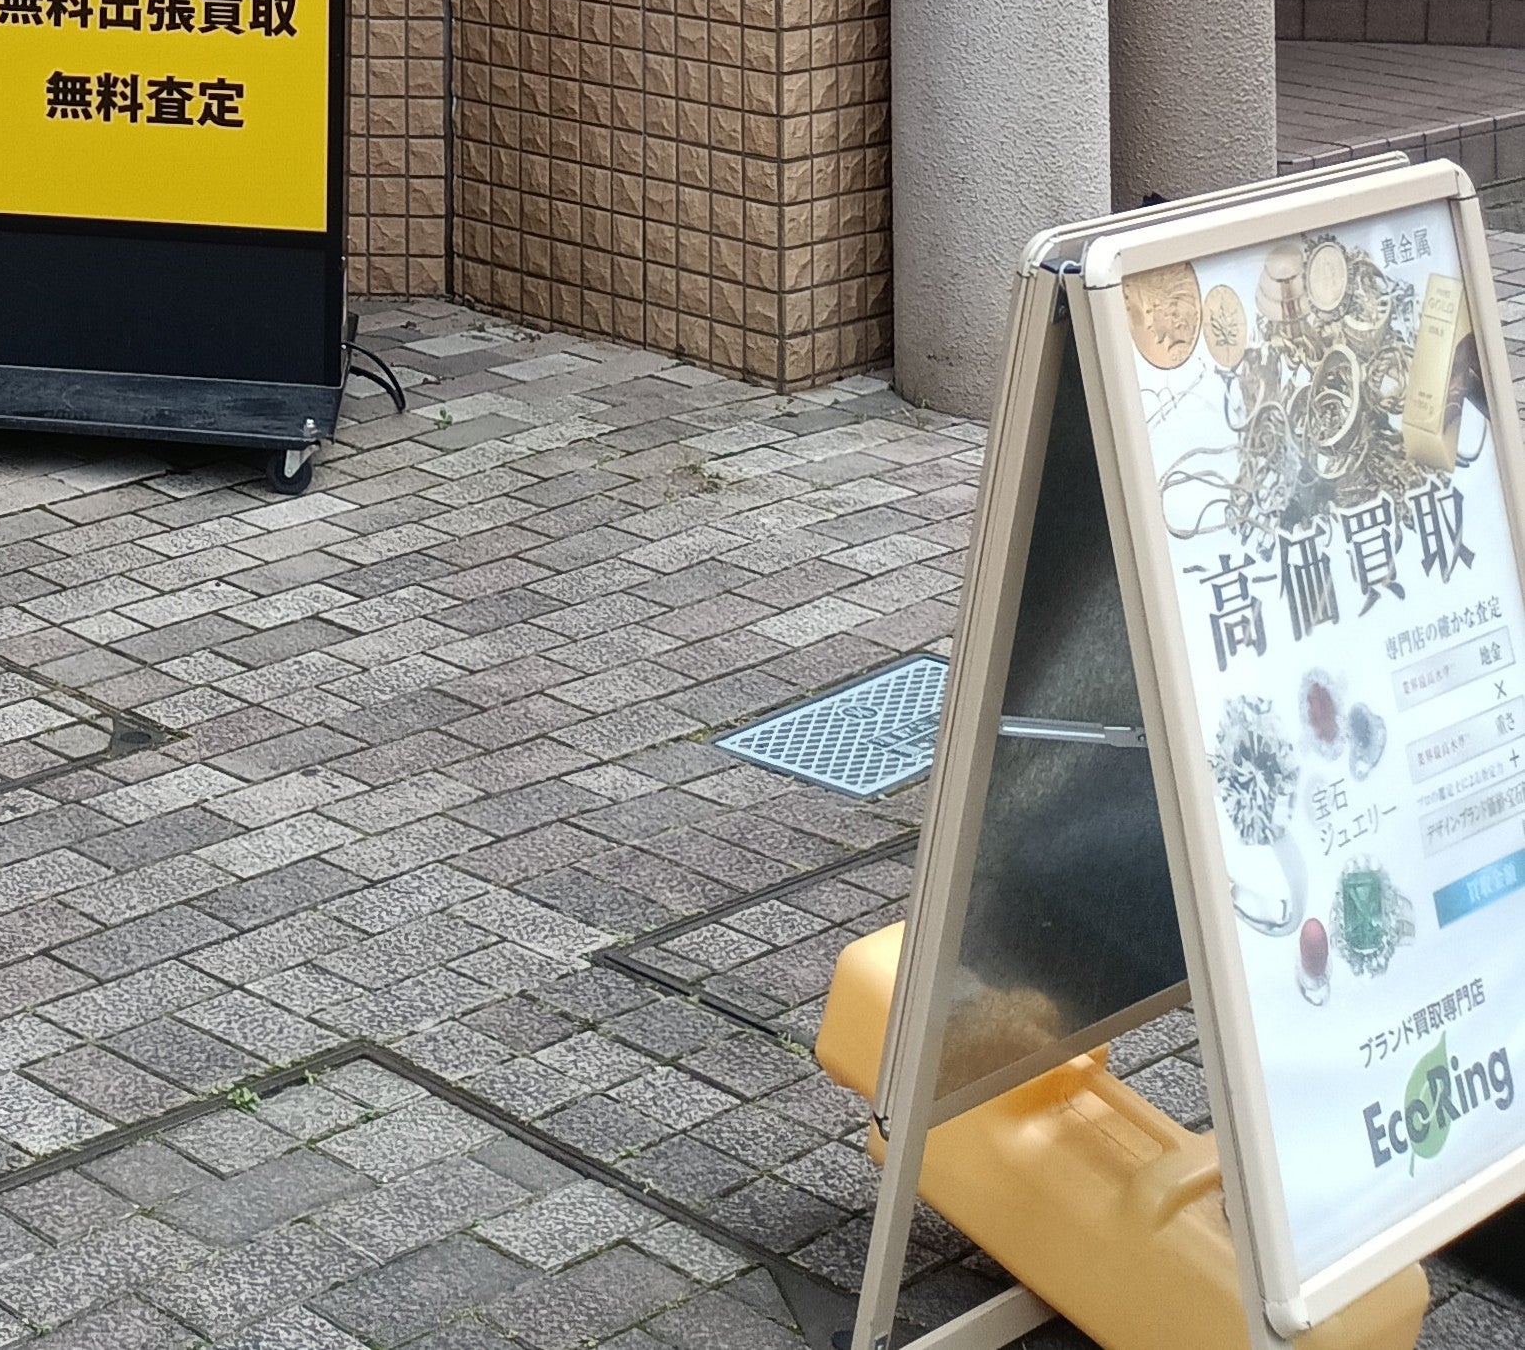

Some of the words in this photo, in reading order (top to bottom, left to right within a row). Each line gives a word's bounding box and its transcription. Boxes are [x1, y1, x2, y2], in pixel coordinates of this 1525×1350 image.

[46, 71, 244, 128] 無料査定
[1380, 228, 1431, 268] 貴金属
[1184, 481, 1476, 672] 高価買取
[1312, 778, 1348, 821] 宝石
[1320, 804, 1397, 856] ジュエリー
[1359, 978, 1486, 1069] ブランド買取専門店
[1362, 1047, 1515, 1168] EcoRing
